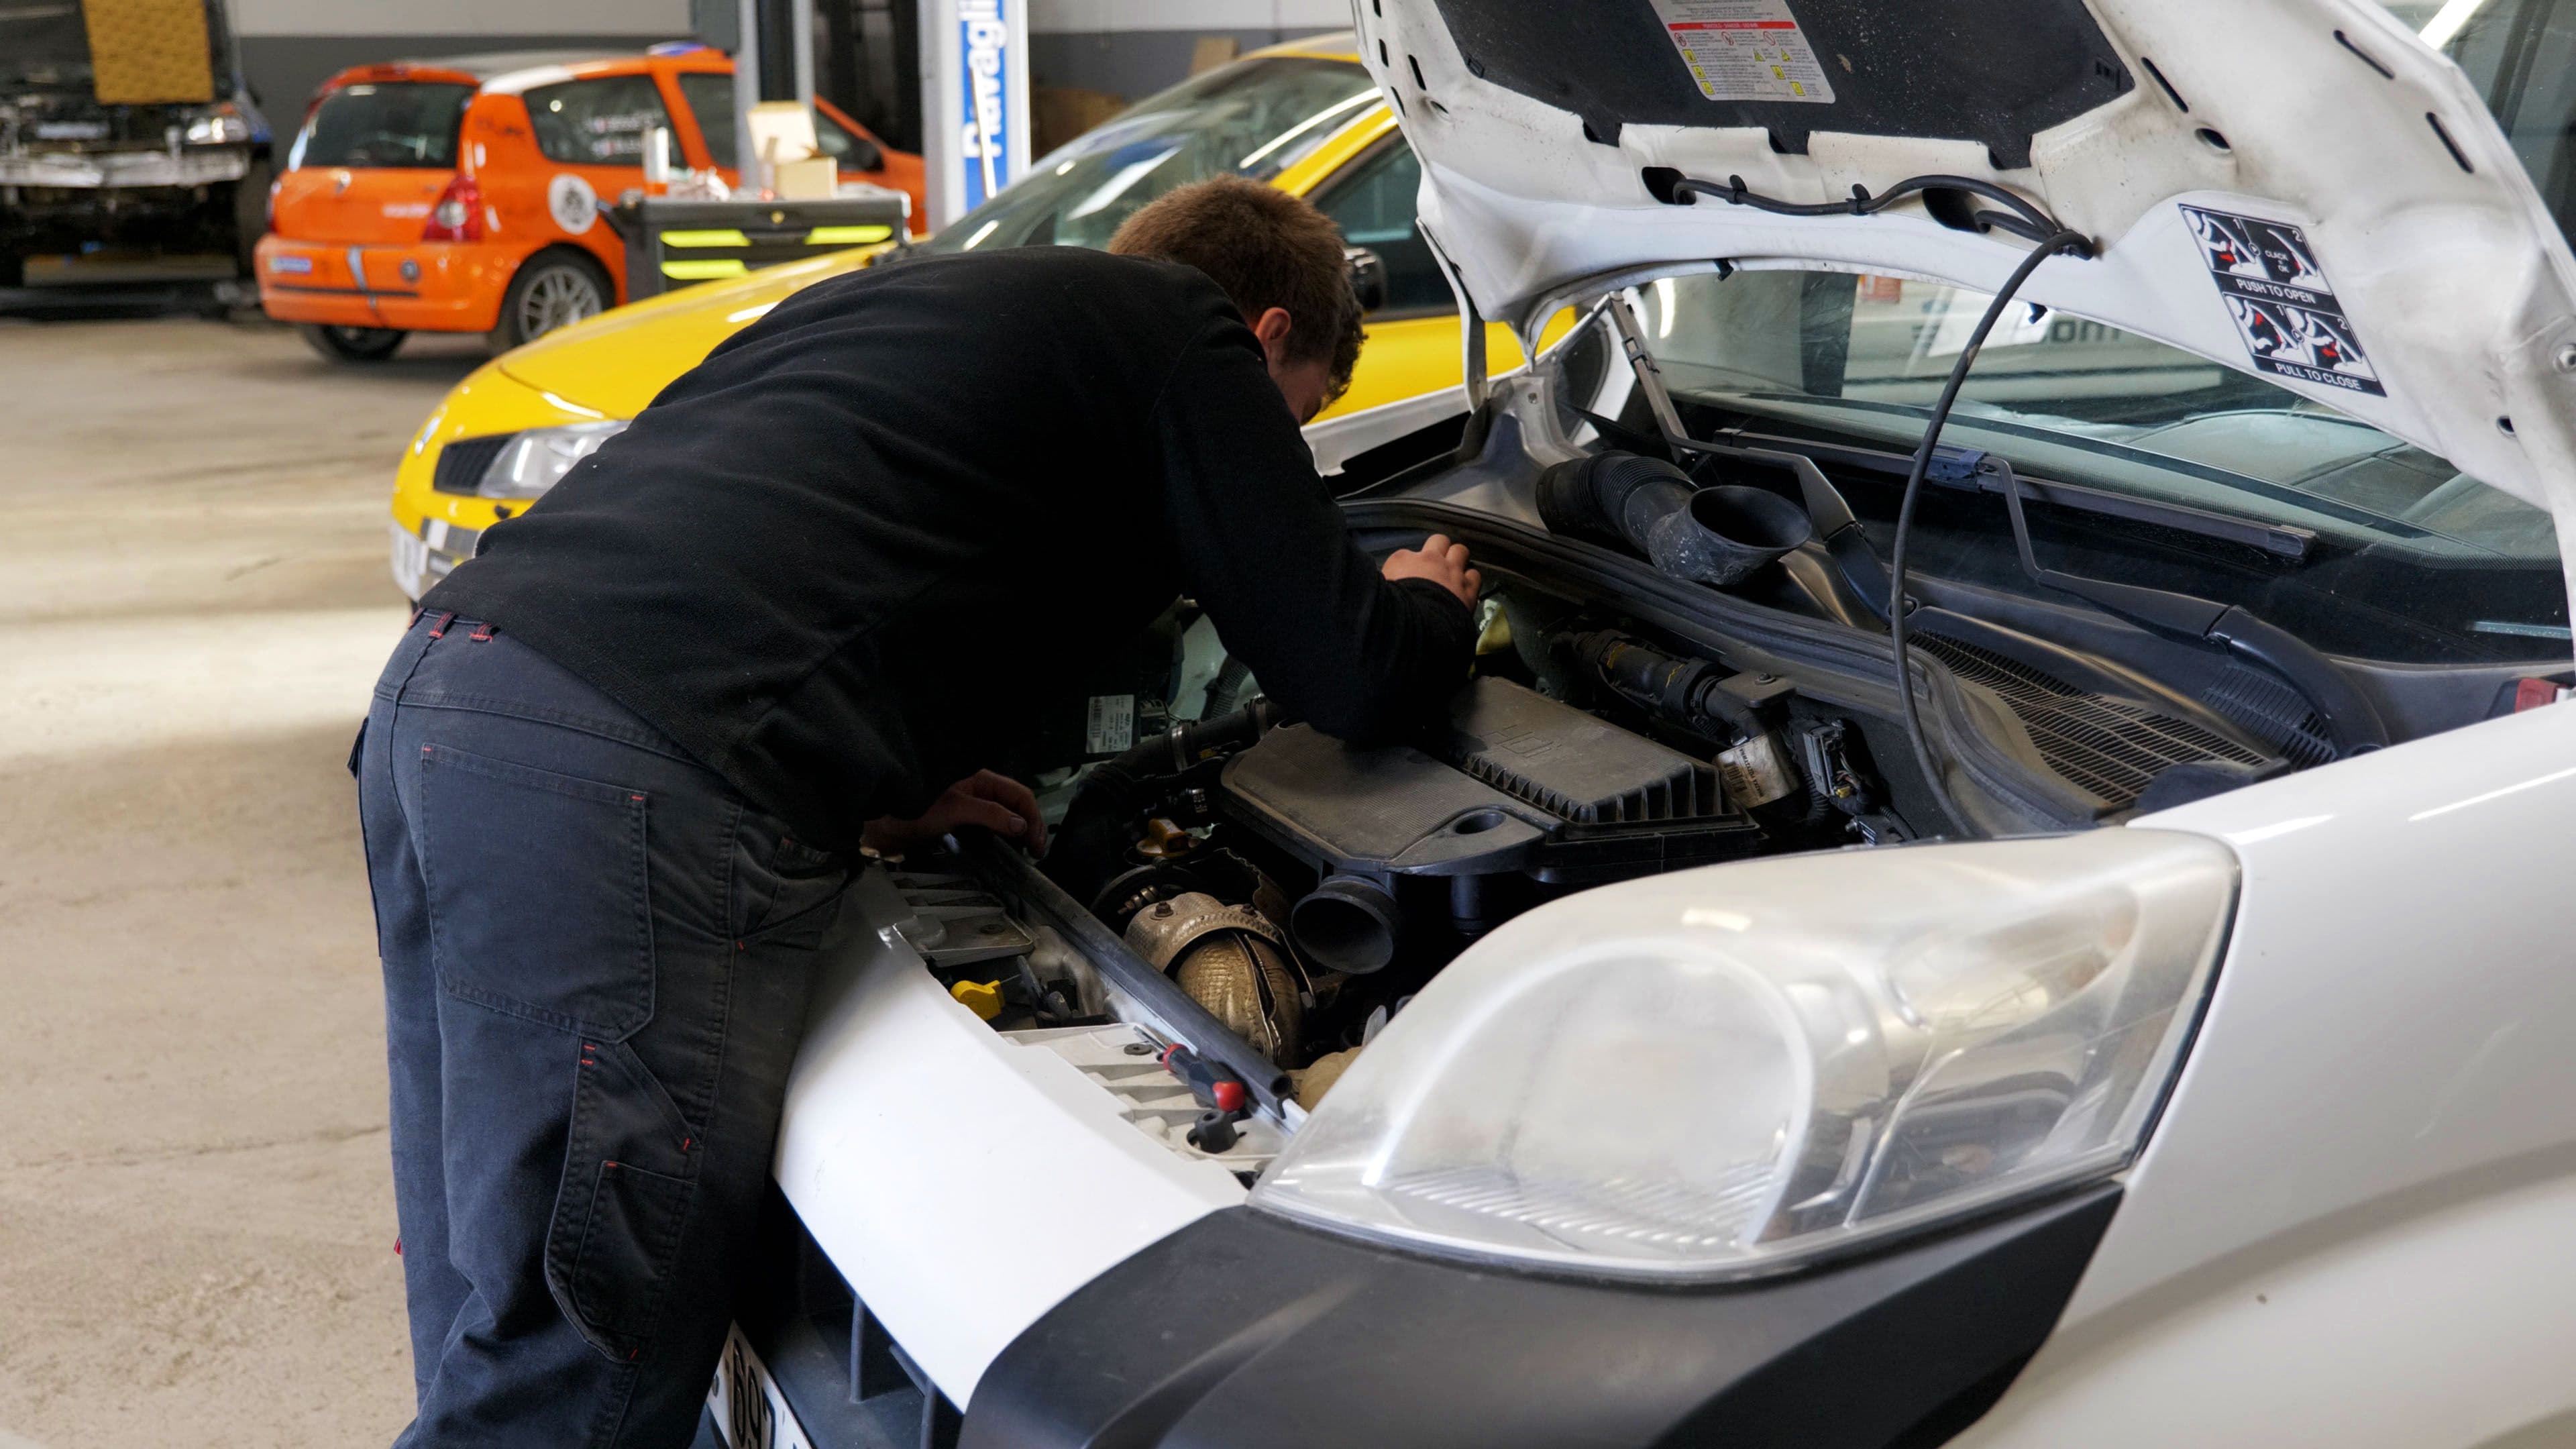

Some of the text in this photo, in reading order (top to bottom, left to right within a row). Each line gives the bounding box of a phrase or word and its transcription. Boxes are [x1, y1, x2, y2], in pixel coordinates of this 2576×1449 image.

[2292, 230, 2302, 242] 2
[2278, 265, 2290, 273] OK
[2235, 278, 2316, 304] PUSH TO OPEN
[2337, 317, 2348, 329] 2
[2275, 363, 2362, 390] PULL TO CLOSE
